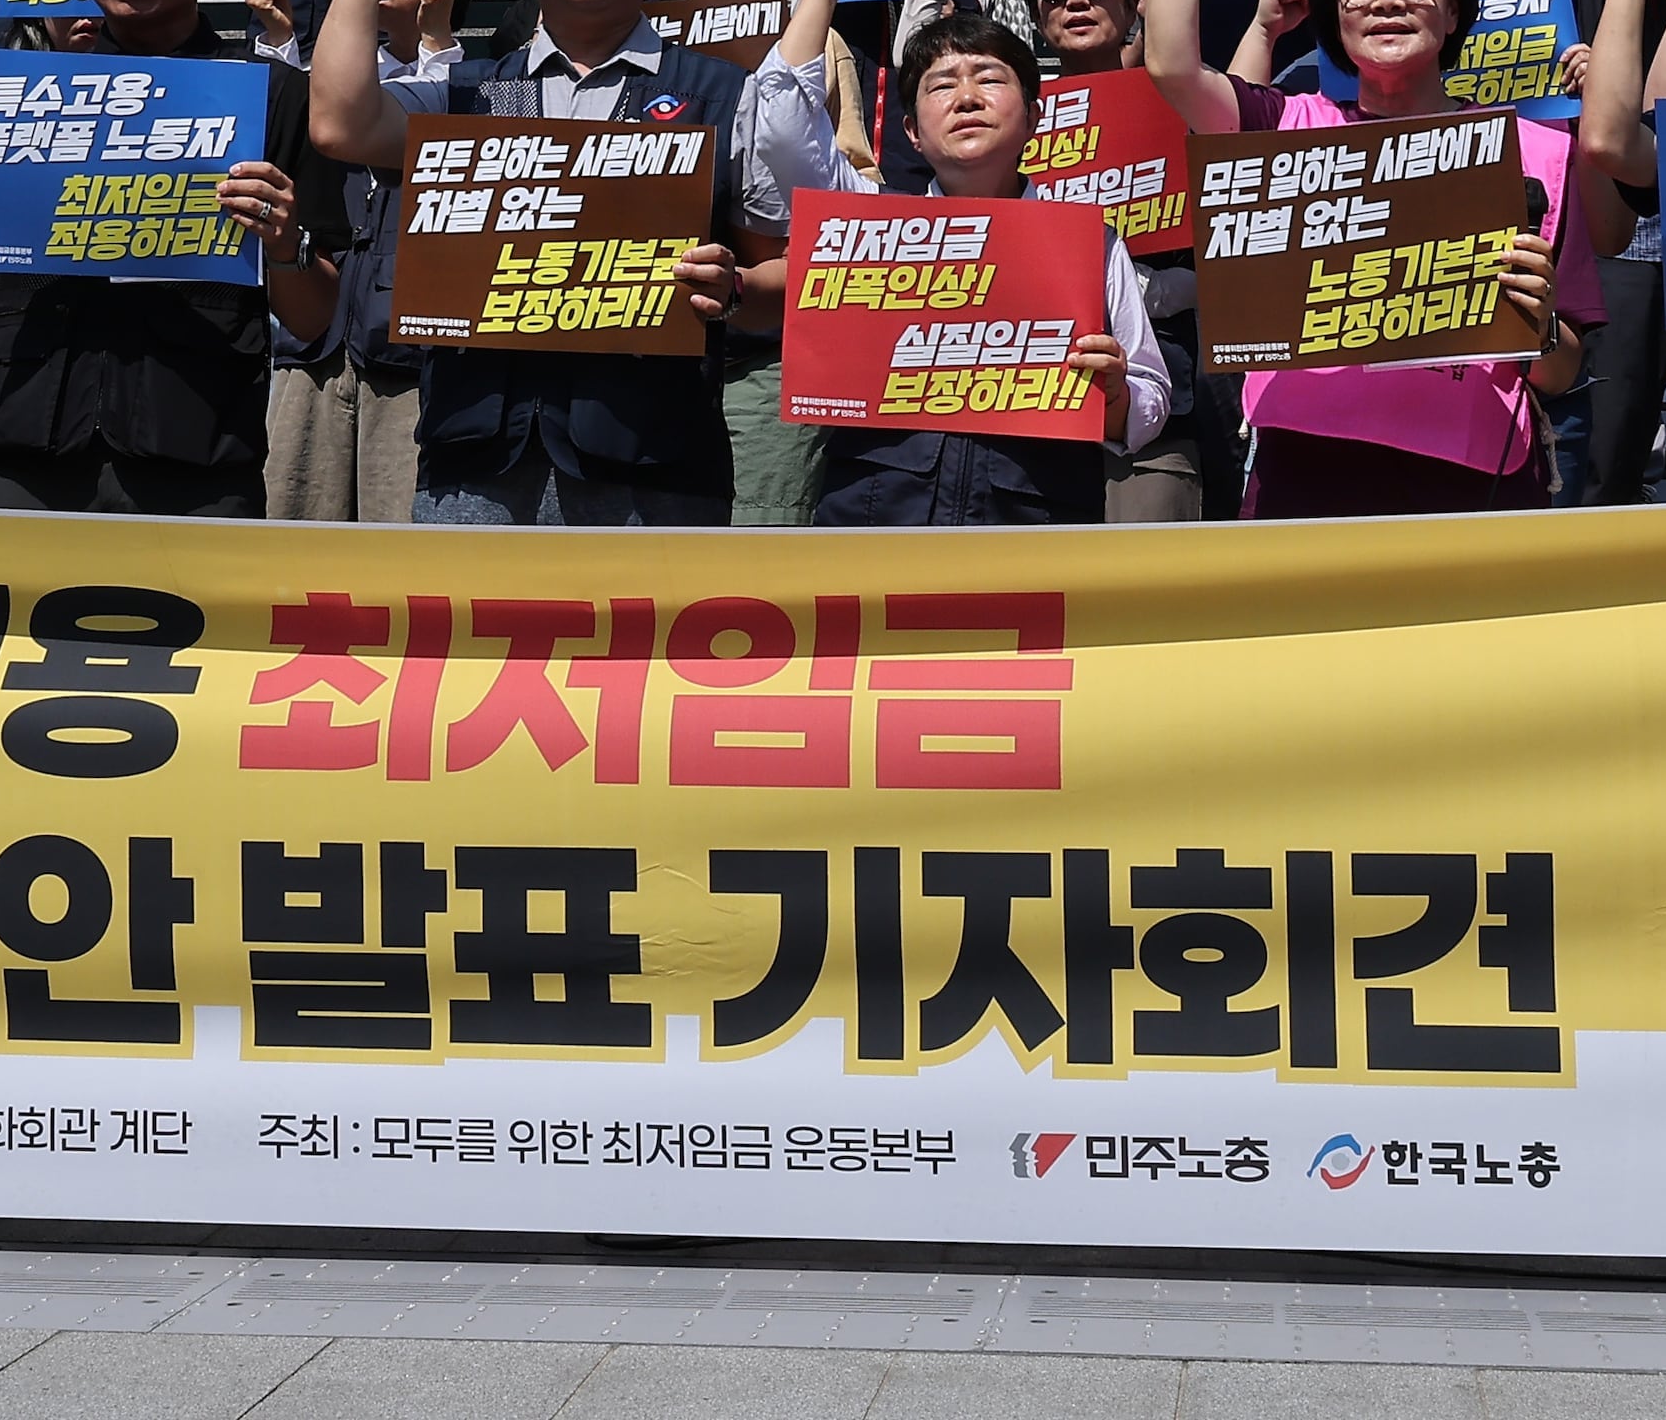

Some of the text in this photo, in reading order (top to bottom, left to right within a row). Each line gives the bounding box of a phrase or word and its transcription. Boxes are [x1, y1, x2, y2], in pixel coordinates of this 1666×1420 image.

[99, 115, 237, 161] 노동자
[409, 130, 705, 184] 모든 일하는 사람에게
[1198, 115, 1507, 207] 모든 일하는 사람에게
[406, 185, 584, 234] 차별 없는
[1203, 194, 1391, 260] 차별 없는
[43, 212, 244, 261] 적용하라!!
[809, 214, 991, 262] 최저임금
[475, 284, 676, 333] 보장하라!!
[796, 262, 996, 310] 대폭인상!
[1296, 279, 1500, 355] 보장하라!!
[889, 318, 1075, 368] 실질임금
[877, 365, 1090, 414] 보장하라!!
[239, 591, 1074, 790] 최저임금
[241, 840, 652, 1051] 발표
[708, 846, 1562, 1074] 기자회견
[110, 1109, 193, 1155] 계단
[371, 1117, 497, 1163] 모두를
[507, 1119, 594, 1165] 위한
[602, 1121, 773, 1170] 최저임금
[783, 1126, 957, 1175] 운동본부
[1085, 1135, 1270, 1183] 민주노총
[1381, 1140, 1561, 1189] 한국노총
